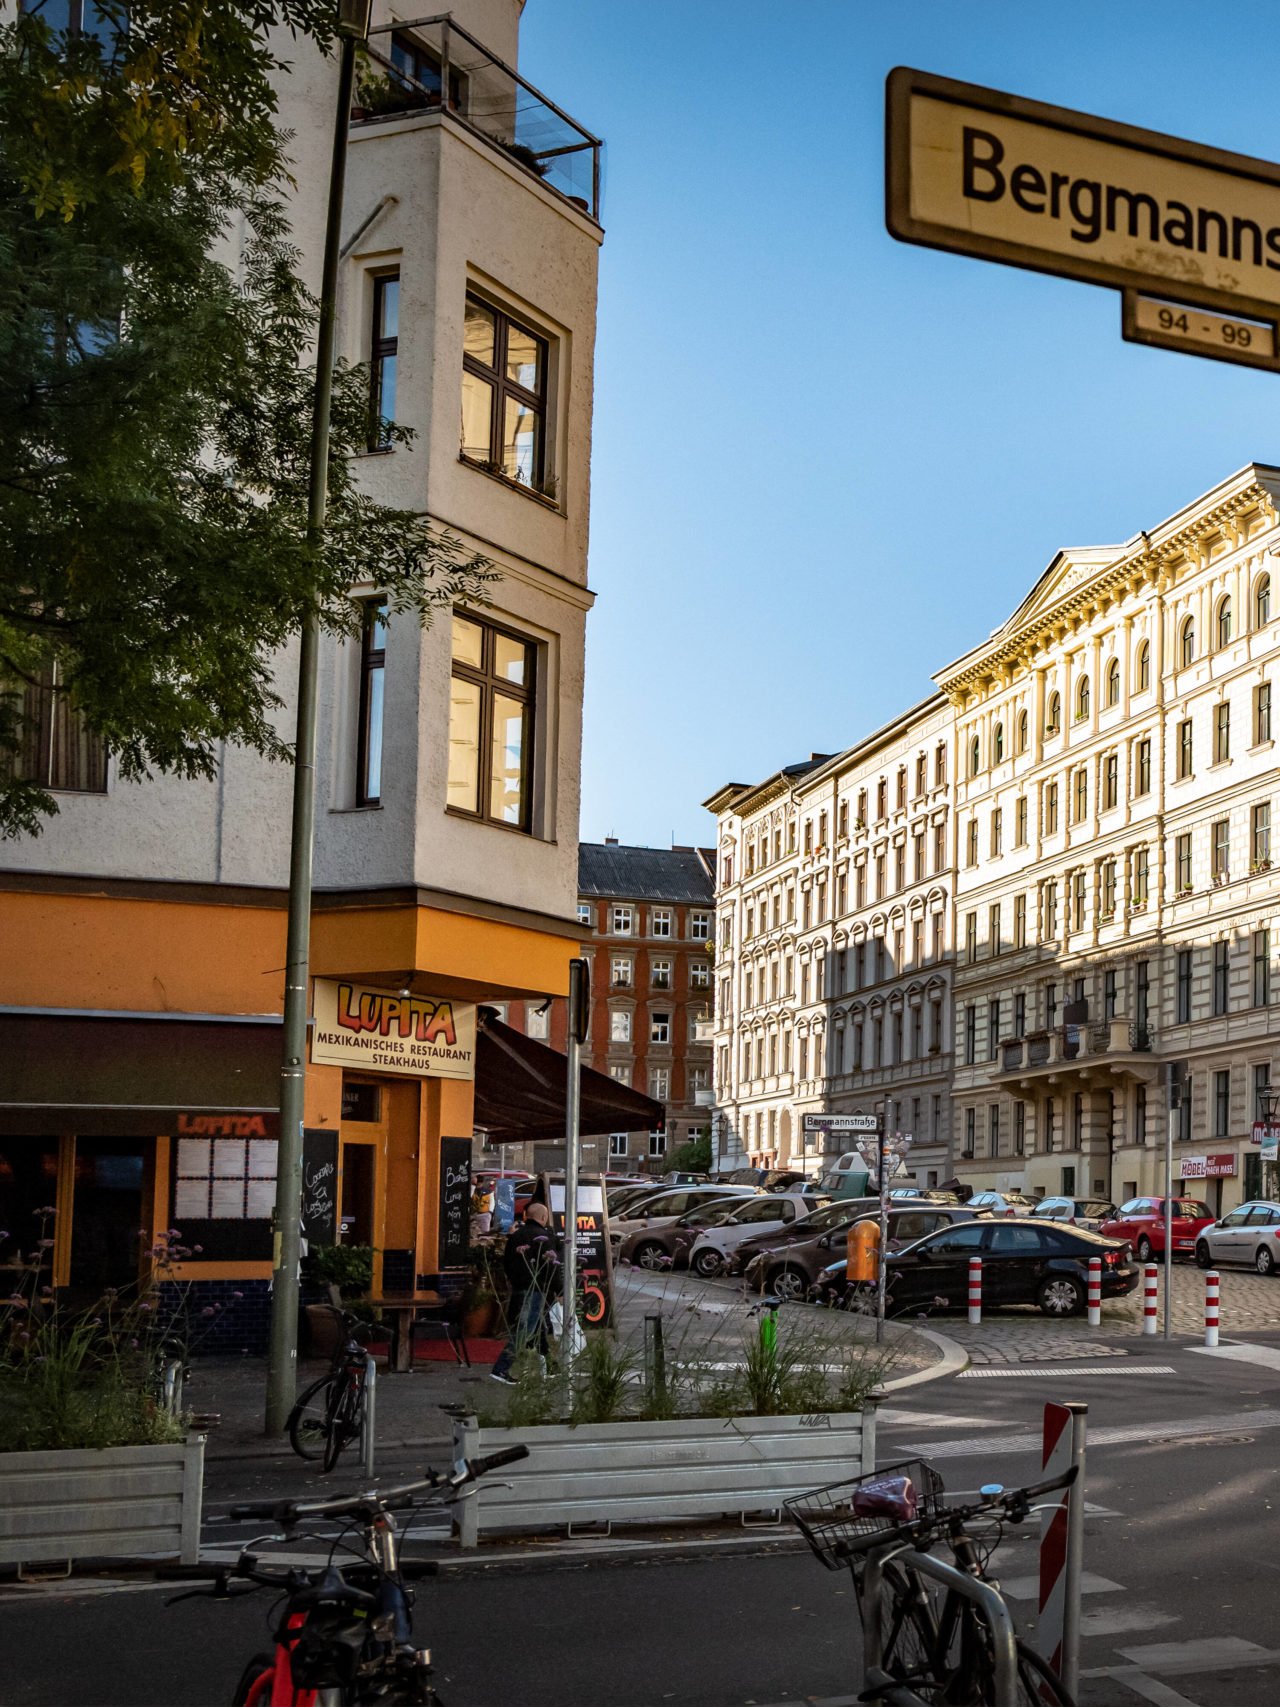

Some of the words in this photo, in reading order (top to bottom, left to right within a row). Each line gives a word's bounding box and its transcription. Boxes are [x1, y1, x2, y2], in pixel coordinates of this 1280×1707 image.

[1157, 307, 1191, 334] 94
[1221, 321, 1253, 349] 99
[337, 983, 457, 1047] LUPITA
[317, 1031, 405, 1054] MEXIKANISCHES
[410, 1044, 472, 1062] RESTAURANT
[372, 1053, 431, 1070] STEAKHAUS
[177, 1112, 267, 1136] LUPITA
